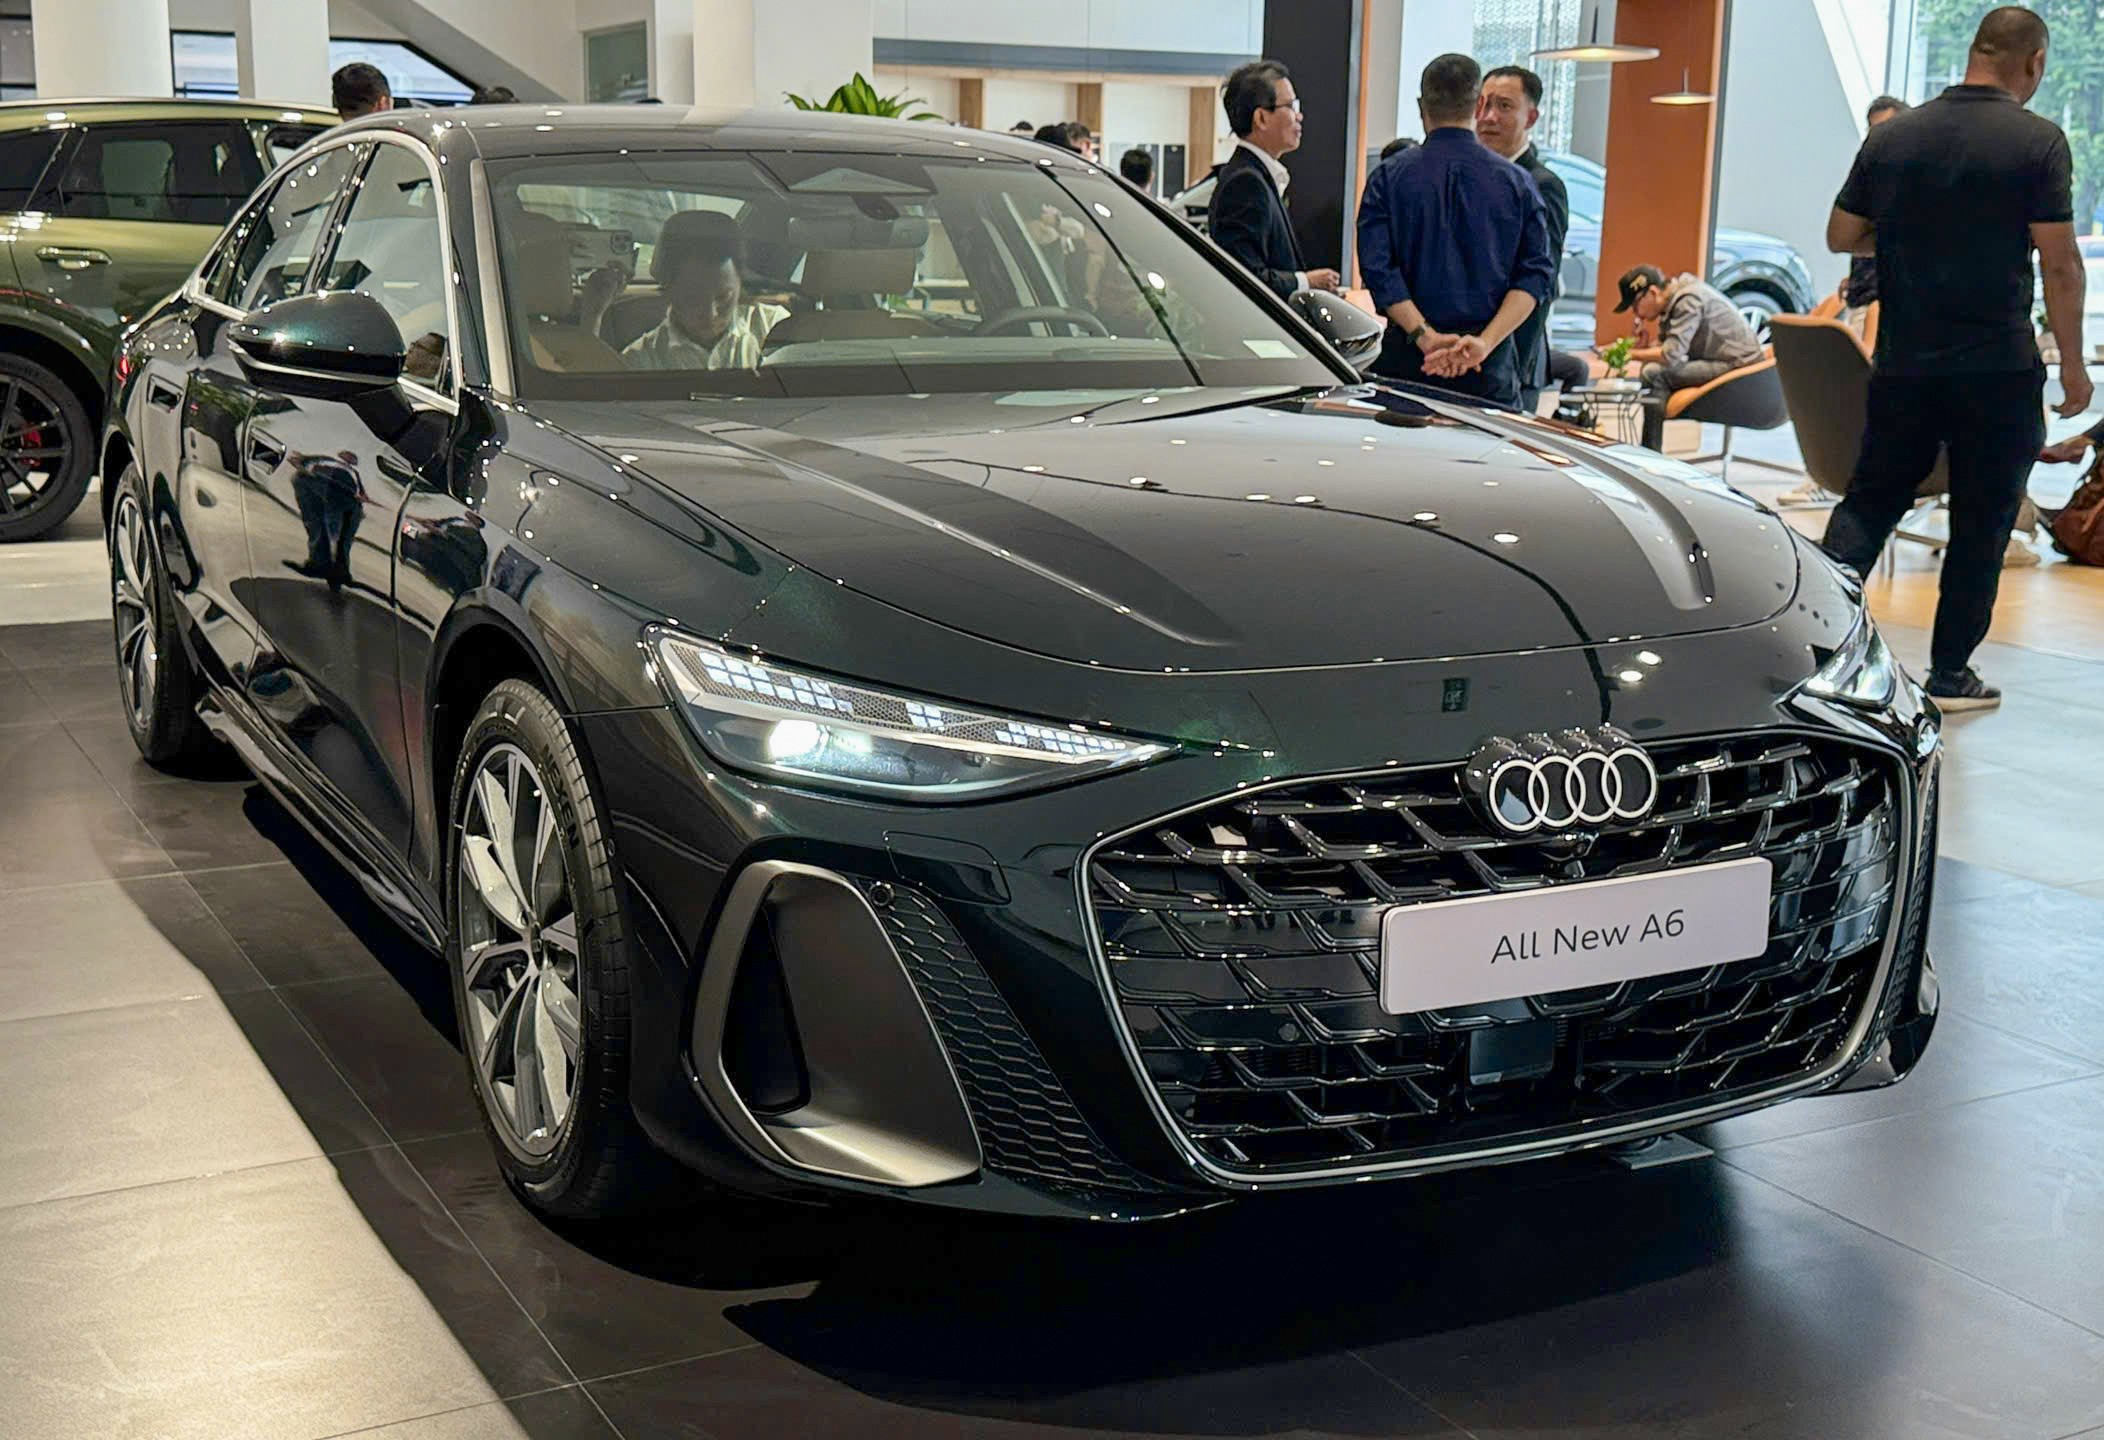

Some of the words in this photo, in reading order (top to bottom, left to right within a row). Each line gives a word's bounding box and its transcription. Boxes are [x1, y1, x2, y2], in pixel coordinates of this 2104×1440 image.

[543, 743, 579, 849] NEXEN
[1491, 931, 1541, 964] All
[1554, 924, 1630, 955] New
[1640, 909, 1685, 942] A6
